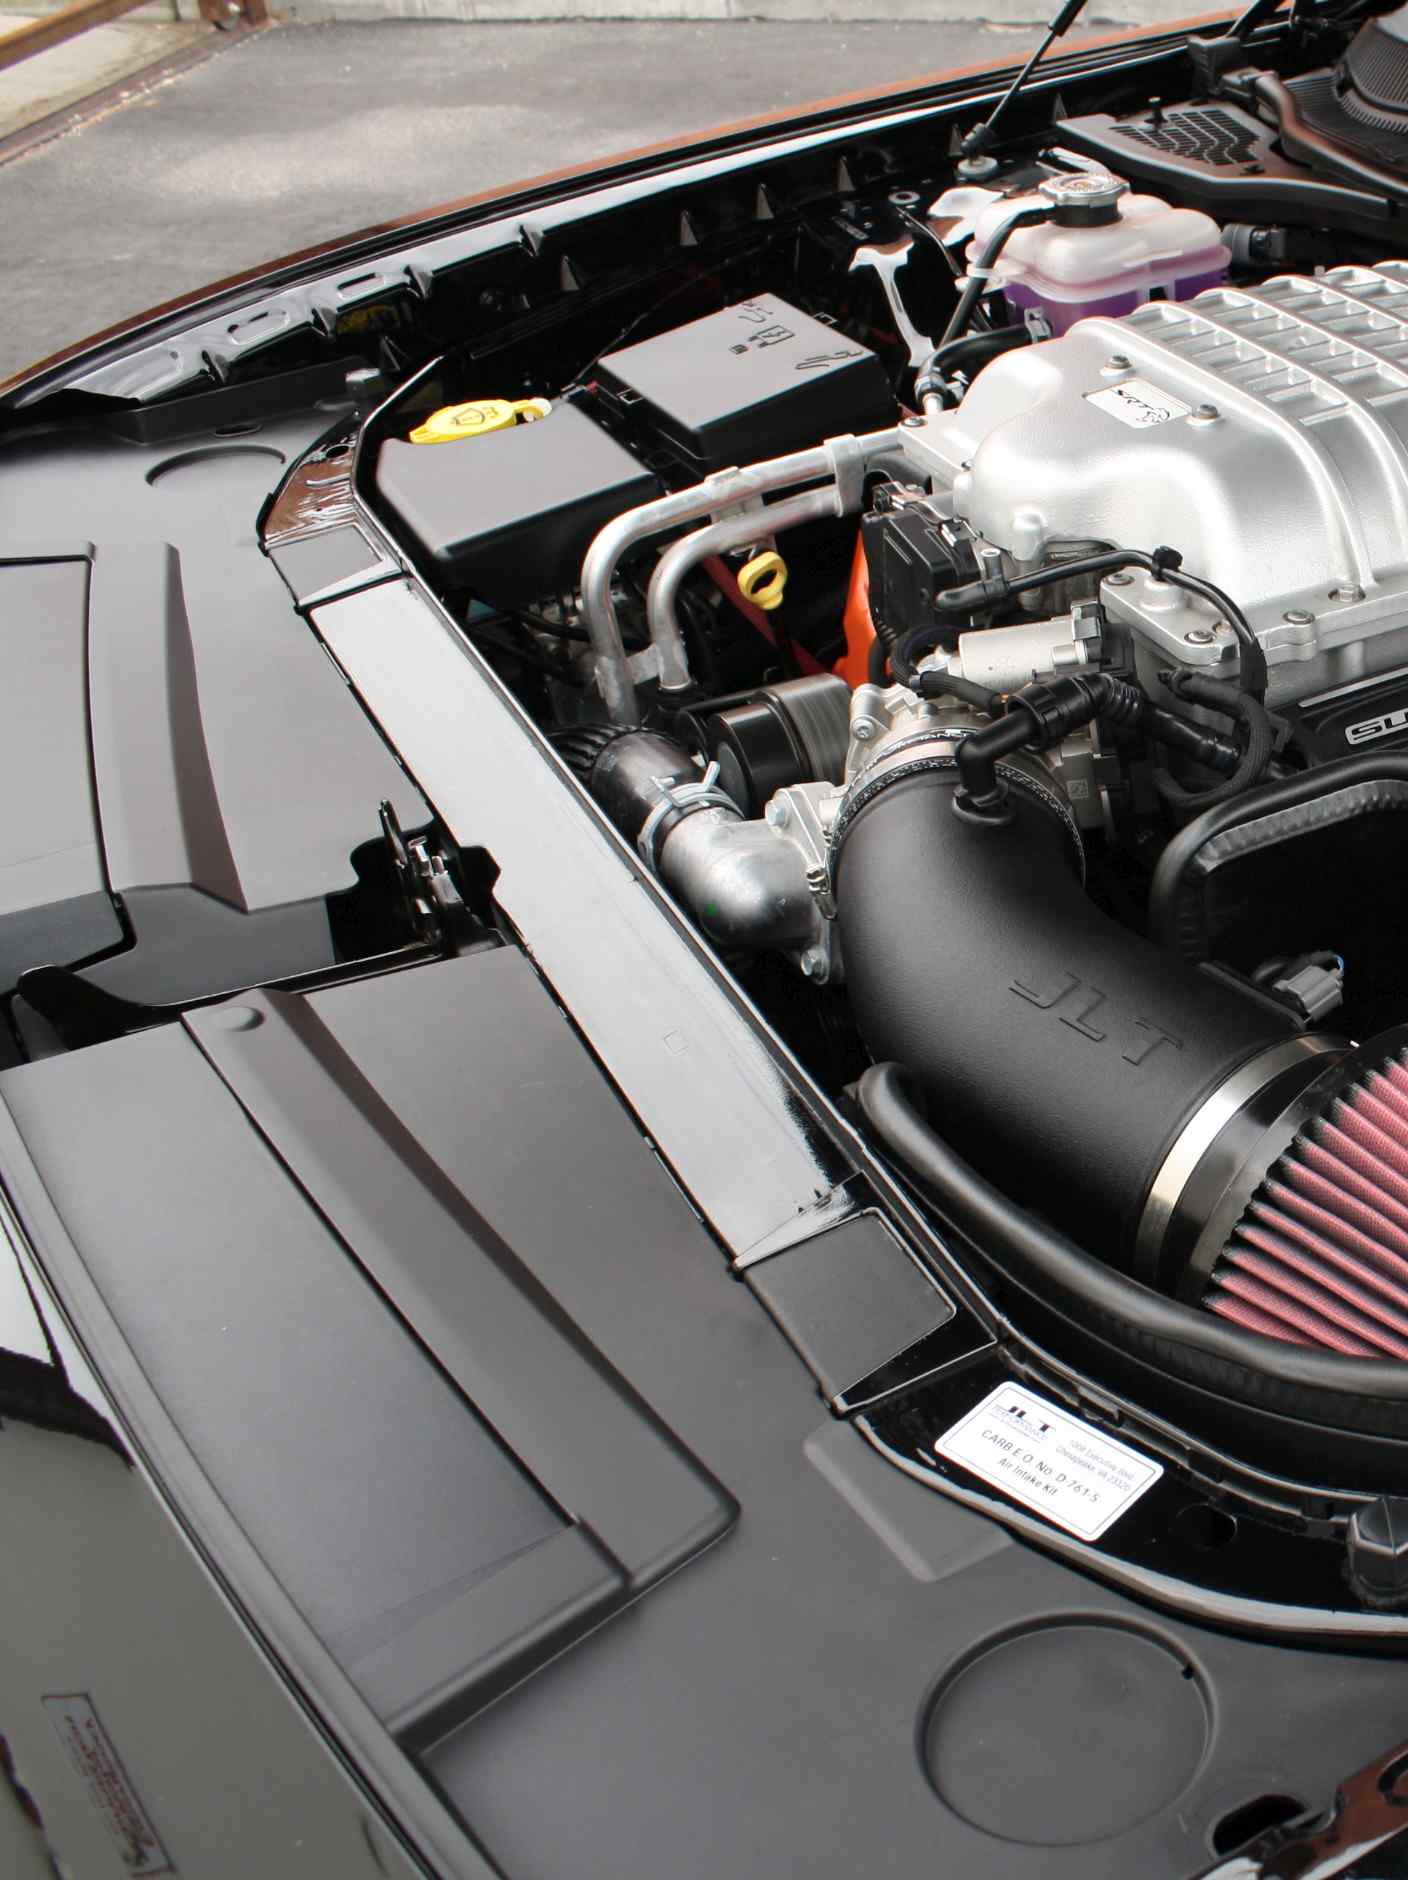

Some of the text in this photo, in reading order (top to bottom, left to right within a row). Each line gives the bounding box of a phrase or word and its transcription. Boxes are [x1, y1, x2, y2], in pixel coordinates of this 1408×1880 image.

[1008, 968, 1185, 1067] JLT
[980, 1429, 1013, 1451] CARB
[998, 1457, 1058, 1495] Air Intake Kit
